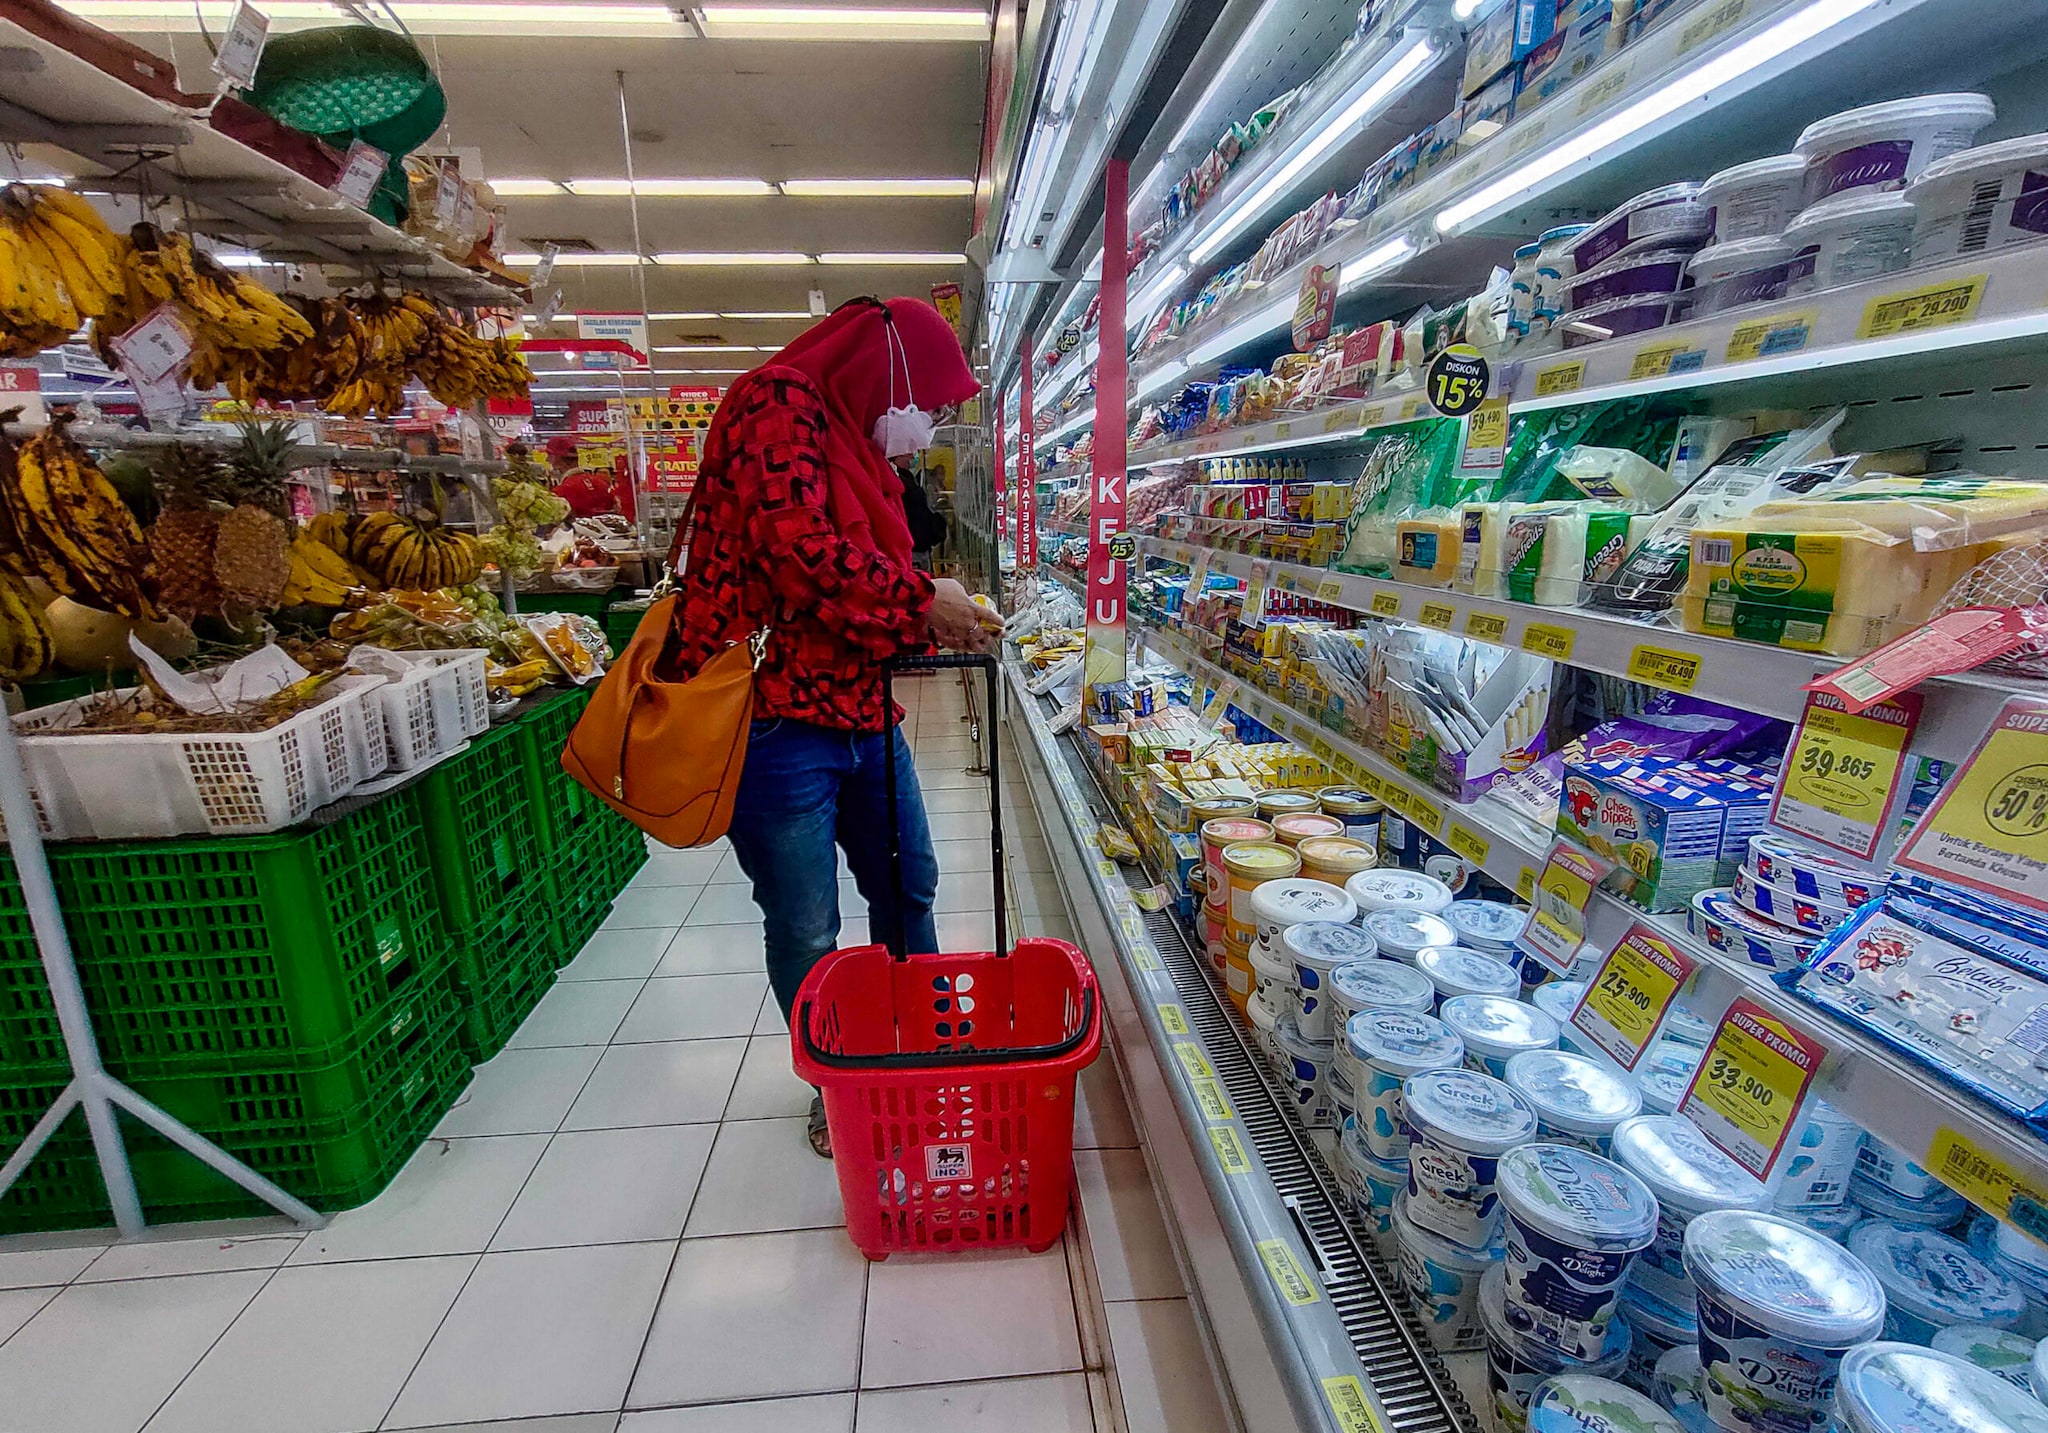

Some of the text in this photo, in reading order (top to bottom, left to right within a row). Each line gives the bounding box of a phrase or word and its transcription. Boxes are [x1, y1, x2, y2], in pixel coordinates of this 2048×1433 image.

[1920, 294, 1969, 317] 29.290
[1445, 361, 1480, 376] DISKON
[1436, 374, 1484, 410] 15%
[1471, 410, 1500, 431] 59.490
[654, 460, 698, 472] GRATIS
[1096, 477, 1121, 624] KEJU
[1111, 543, 1135, 558] 25%
[1666, 662, 1695, 680] 46.490
[1800, 747, 1876, 780] 39.865
[1605, 797, 1633, 817] Cheez
[1601, 809, 1638, 829] Dippers
[1939, 831, 1969, 849] Untuk
[1971, 840, 2015, 863] Barang
[1774, 868, 1782, 879] 8
[1938, 847, 2028, 881] Bertanda Khusus
[1822, 916, 1832, 926] 8
[1725, 937, 1734, 947] 8
[1627, 934, 1652, 957] SUPER
[1650, 951, 1684, 979] PROMO!
[1933, 957, 2018, 994] Belcube
[1601, 971, 1651, 1011] 25.900
[1375, 1020, 1426, 1037] Greek
[1732, 1011, 1811, 1069] SUPER PROMO!
[1709, 1059, 1774, 1107] 33.900
[1437, 1083, 1493, 1107] Greek
[935, 1168, 966, 1177] INDO
[1419, 1156, 1465, 1183] Greek
[1539, 1157, 1598, 1223] Delight
[1562, 1256, 1606, 1278] Delight
[1943, 1254, 1985, 1296] Greek
[1738, 1357, 1836, 1402] Delight
[1777, 1367, 1821, 1385] Fruit
